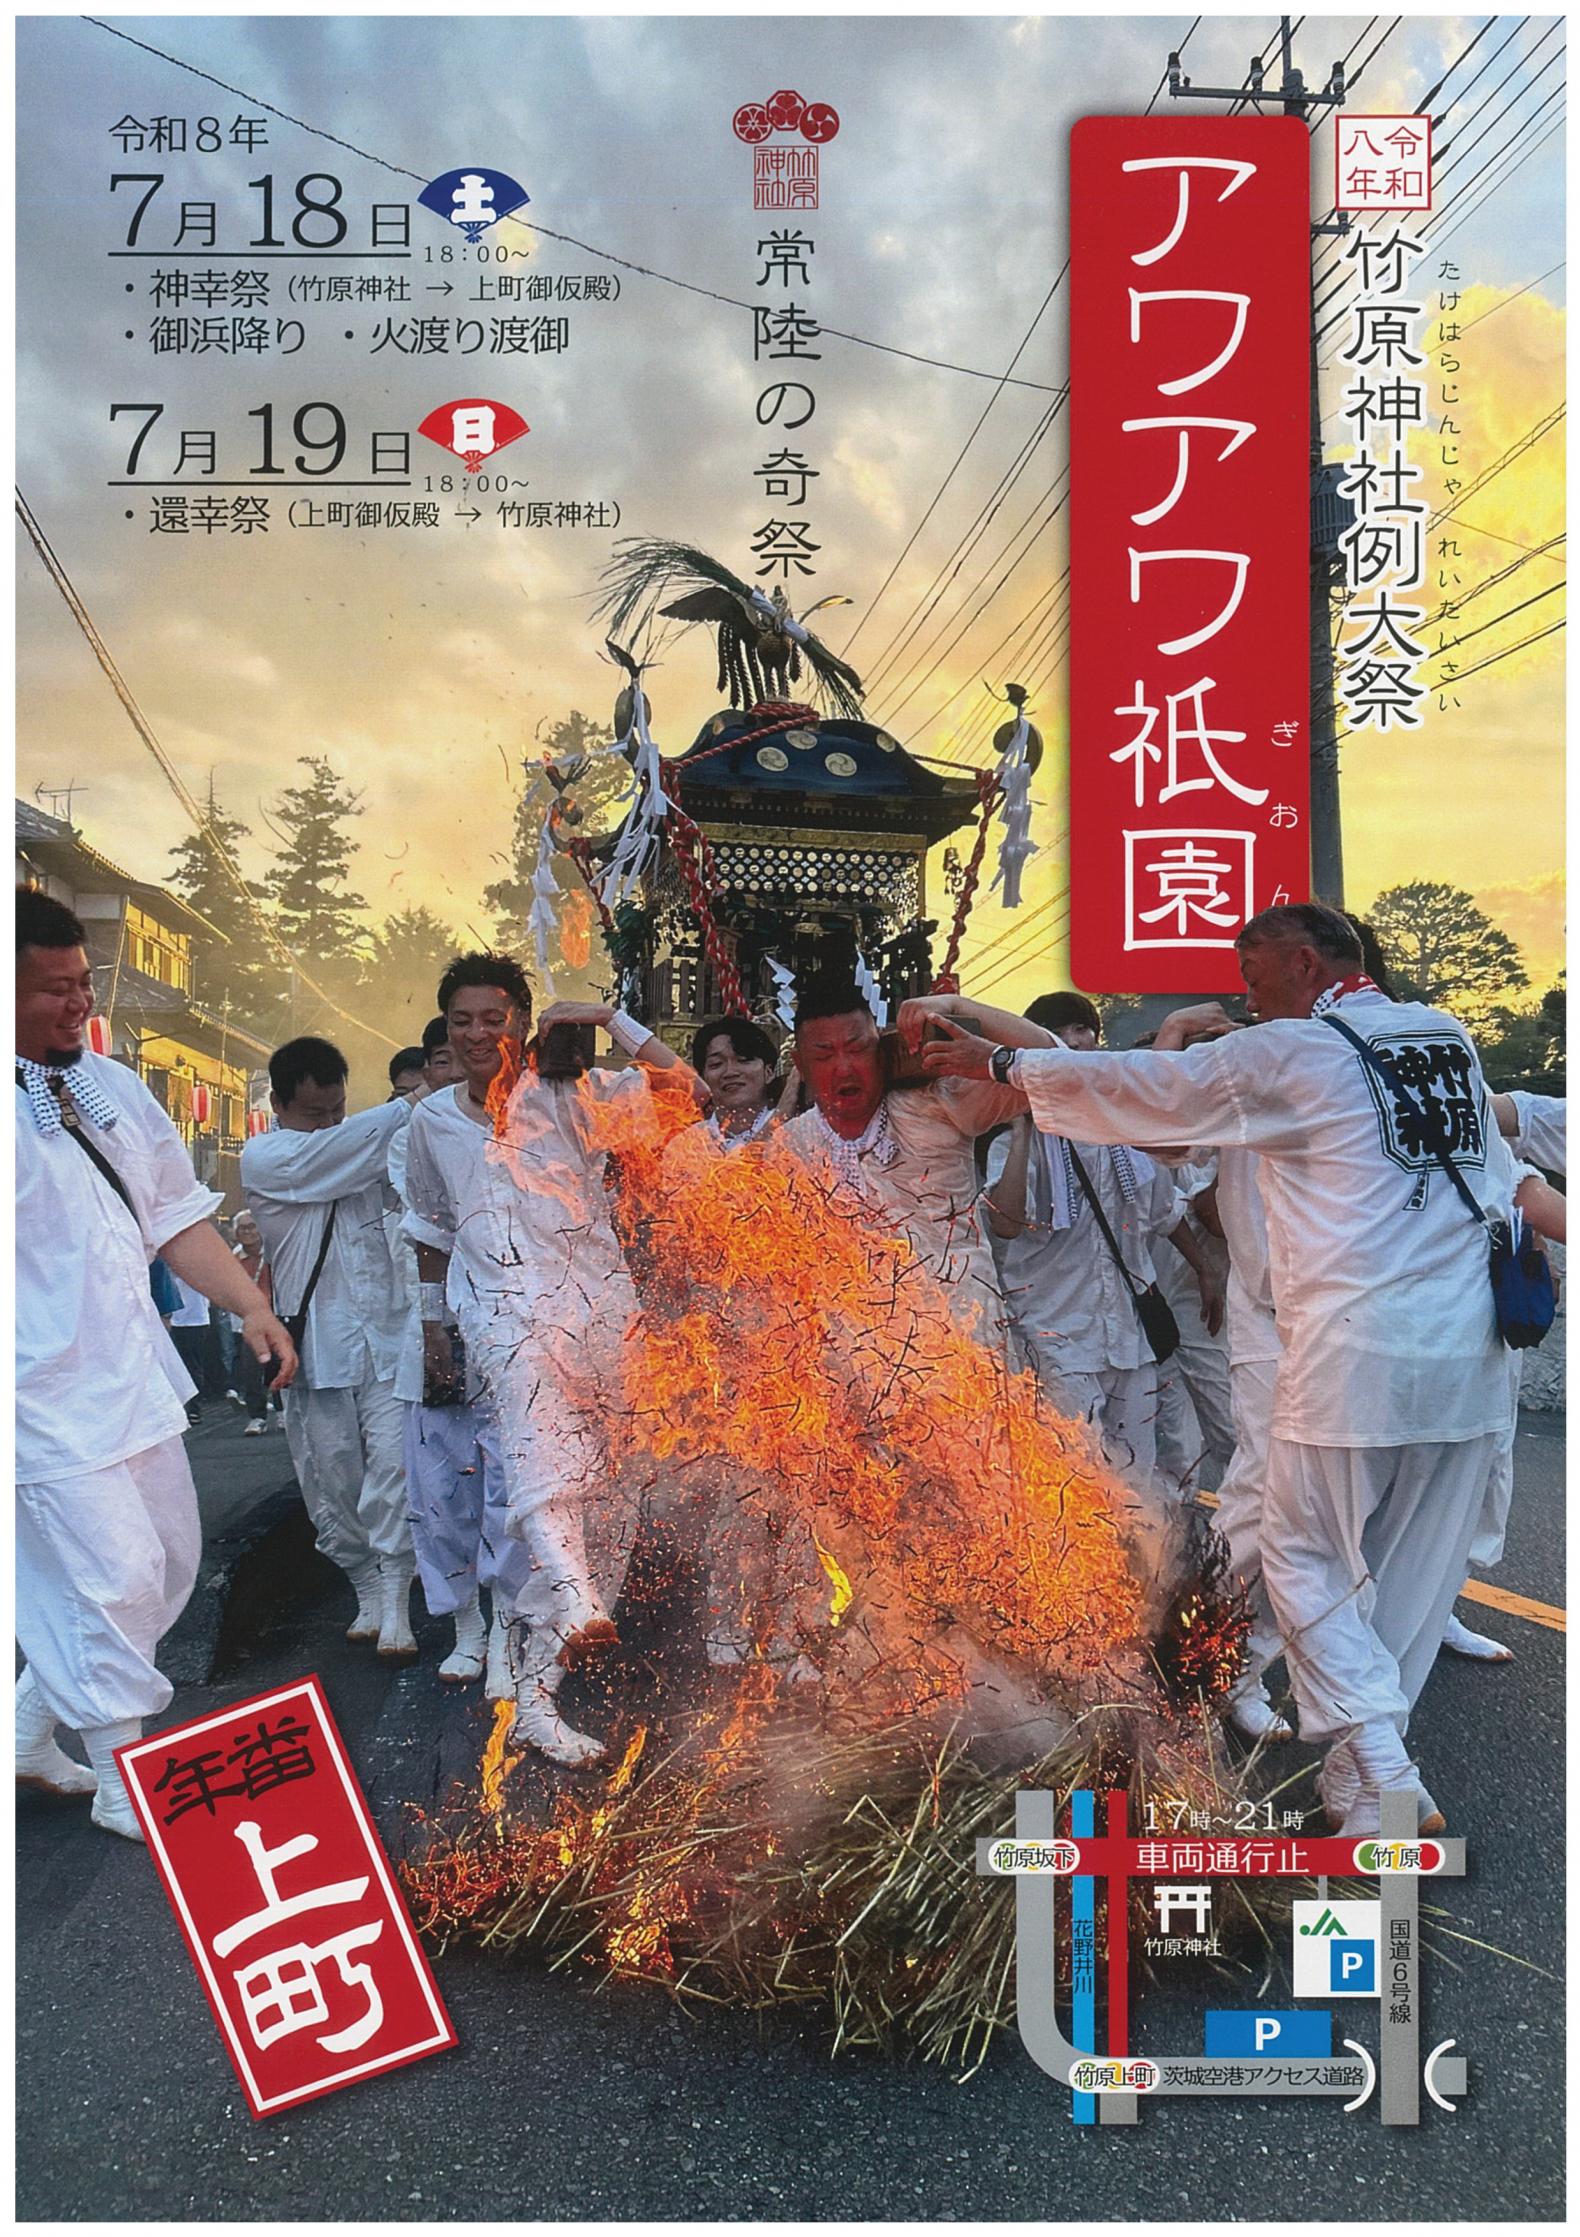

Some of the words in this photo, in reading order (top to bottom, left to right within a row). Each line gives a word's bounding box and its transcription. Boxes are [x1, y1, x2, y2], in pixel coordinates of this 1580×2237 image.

[107, 114, 270, 155] 令和8年
[450, 173, 496, 225] 土
[1437, 259, 1463, 497] たけはらじんじゃ
[749, 228, 823, 580] 常陸の奇祭
[450, 405, 497, 455] 日
[1342, 227, 1426, 728] 竹原神社例大祭
[1437, 537, 1463, 713] れいたいさい
[994, 1847, 1075, 1868] 竹原坂下
[1135, 1842, 1311, 1874] 車両通行止
[1371, 1845, 1422, 1869] 竹原
[212, 1820, 385, 2054] 上町
[1073, 1919, 1094, 1994] 花野井川
[1143, 1937, 1223, 1958] 竹原神社
[1342, 1952, 1364, 1979] P
[1388, 1918, 1413, 2024] 国道6号線
[1254, 2017, 1282, 2052] P
[1074, 2065, 1156, 2087] 竹原上町
[1162, 2066, 1365, 2088] 茨城空港アクセス道路
